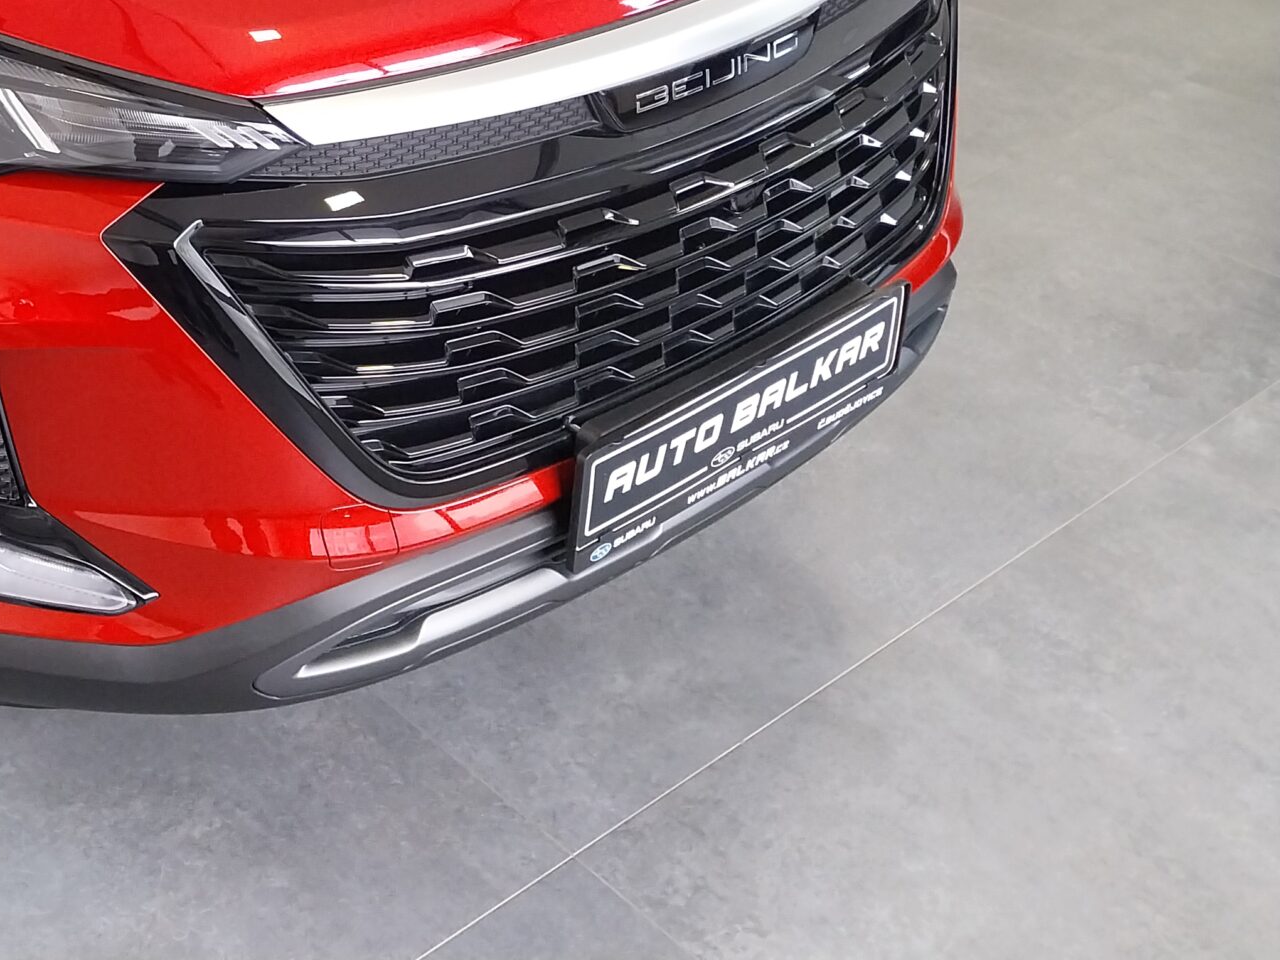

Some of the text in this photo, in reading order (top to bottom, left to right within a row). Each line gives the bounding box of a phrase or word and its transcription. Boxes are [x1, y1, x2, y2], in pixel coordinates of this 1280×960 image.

[603, 321, 886, 503] AUTO BALKAR
[736, 418, 785, 452] SUBARU
[613, 516, 656, 548] SUBARU
